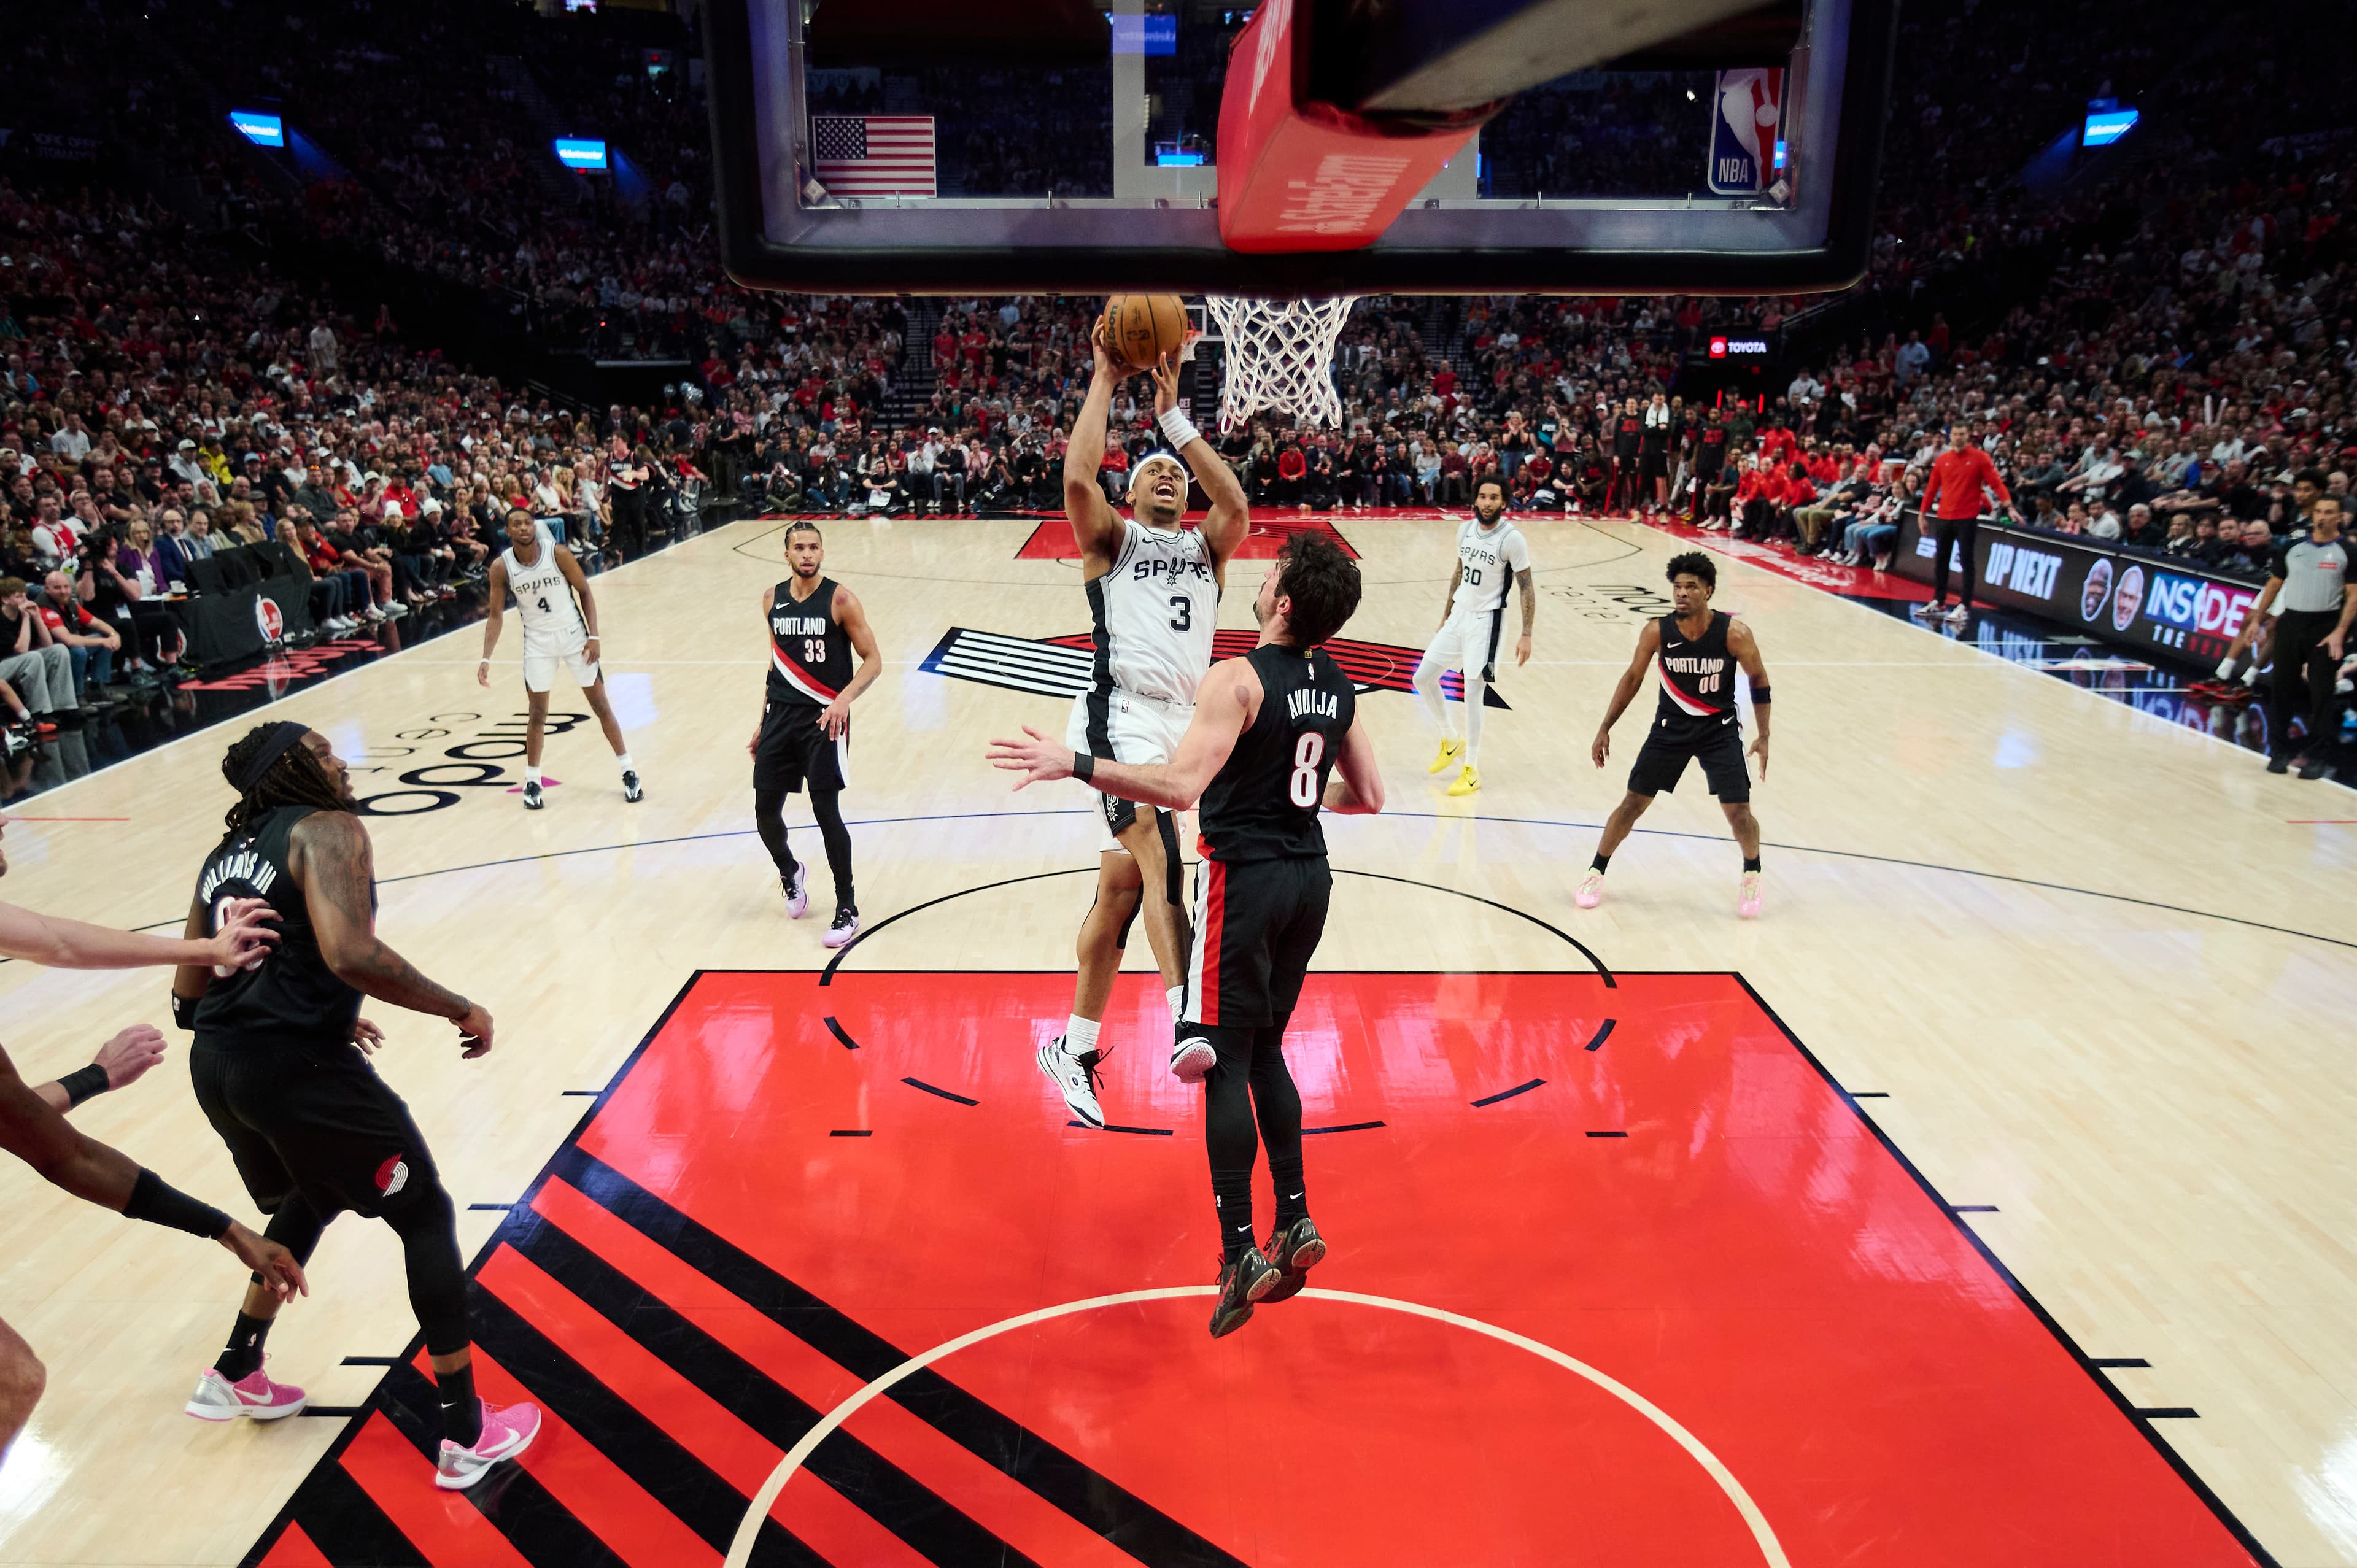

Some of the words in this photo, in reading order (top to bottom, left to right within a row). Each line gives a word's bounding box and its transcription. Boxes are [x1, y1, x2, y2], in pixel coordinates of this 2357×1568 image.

[1718, 158, 1749, 183] NBA
[1728, 341, 1767, 353] TOYOTA
[1460, 547, 1495, 565] SPURS
[1463, 565, 1482, 585] 30
[1984, 541, 2016, 587] UP
[2008, 547, 2063, 600] NEXT
[515, 576, 561, 595] SPURS
[538, 596, 551, 612] 4
[1169, 595, 1191, 632] 3
[2145, 574, 2254, 638] INSIDE
[773, 617, 826, 636] PORTLAND
[2152, 623, 2186, 649] THE
[804, 638, 826, 663] 33
[1664, 657, 1724, 674] PORTLAND
[1698, 673, 1720, 695] 00
[1287, 688, 1338, 720] AVDIJA
[1290, 730, 1325, 808] 8
[252, 860, 277, 895] III
